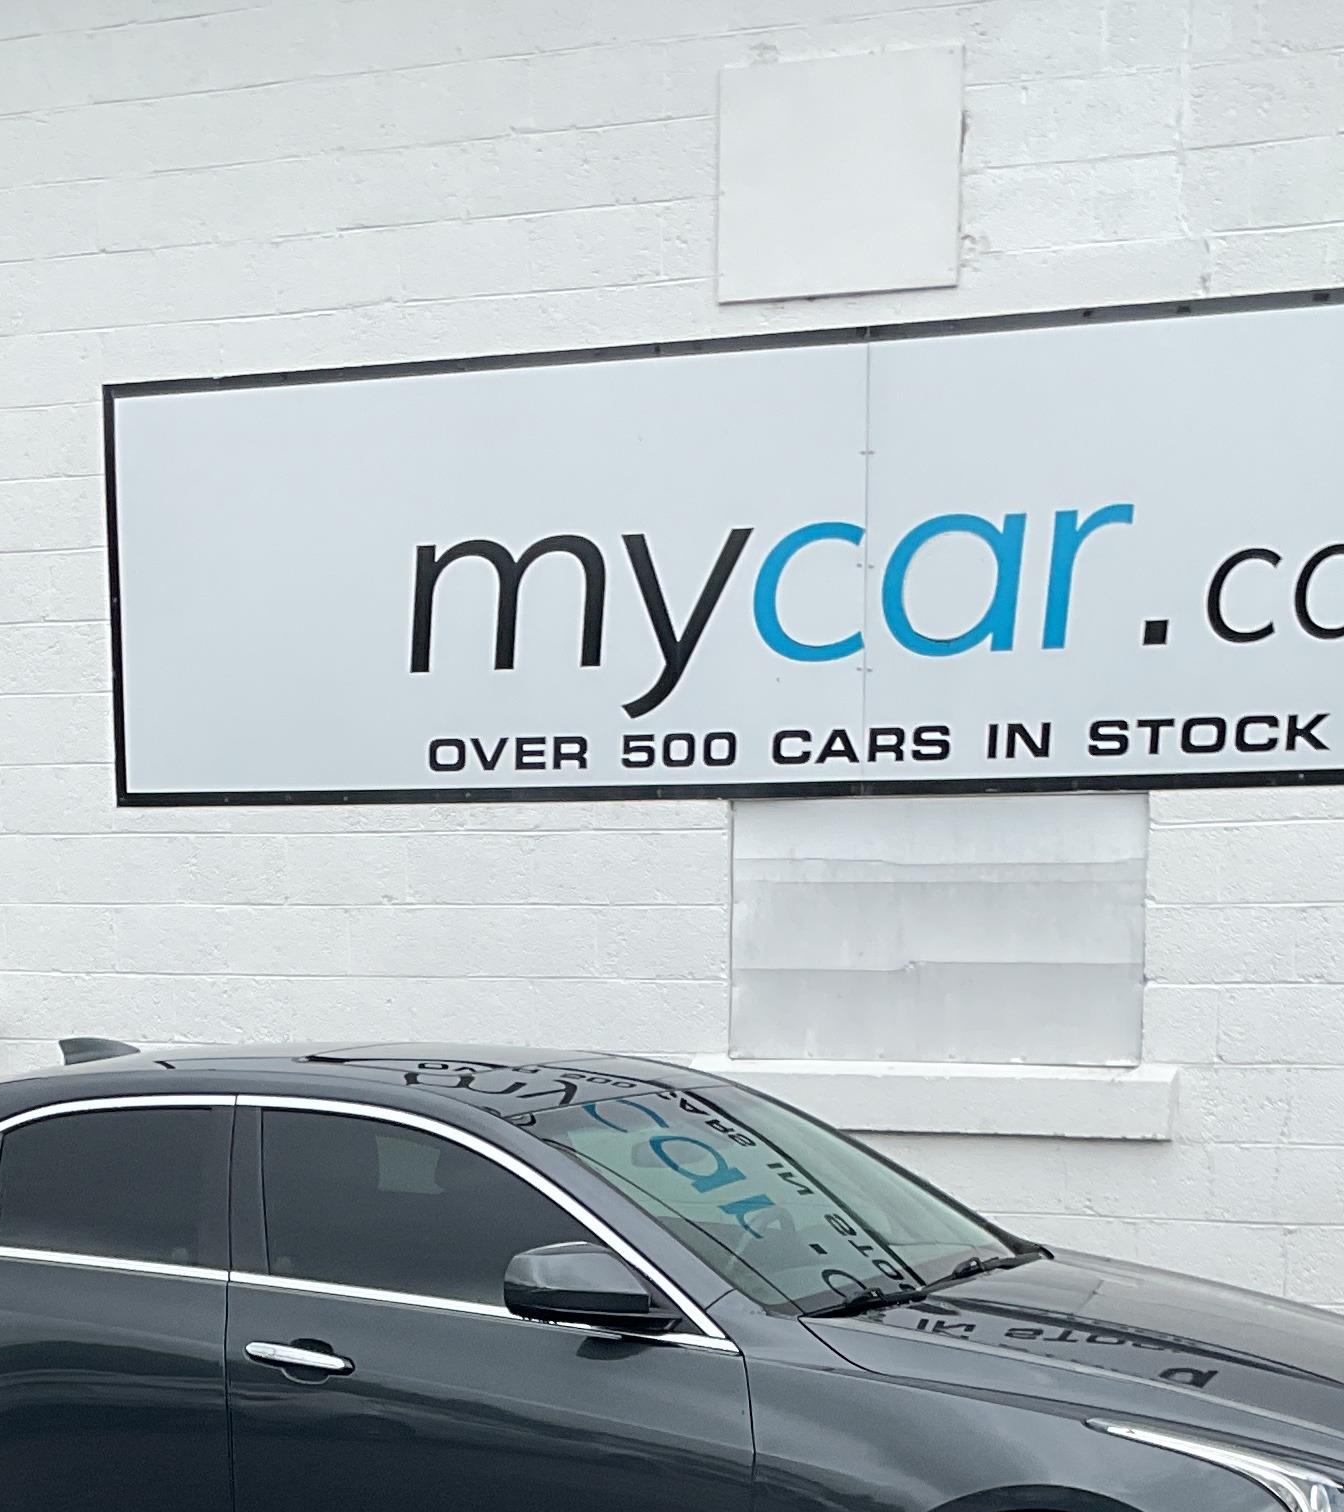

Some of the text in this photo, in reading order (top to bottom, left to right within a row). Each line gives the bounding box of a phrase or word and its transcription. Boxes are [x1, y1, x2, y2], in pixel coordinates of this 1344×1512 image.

[429, 713, 1330, 772] OVER 500 CARS IN STOCK
